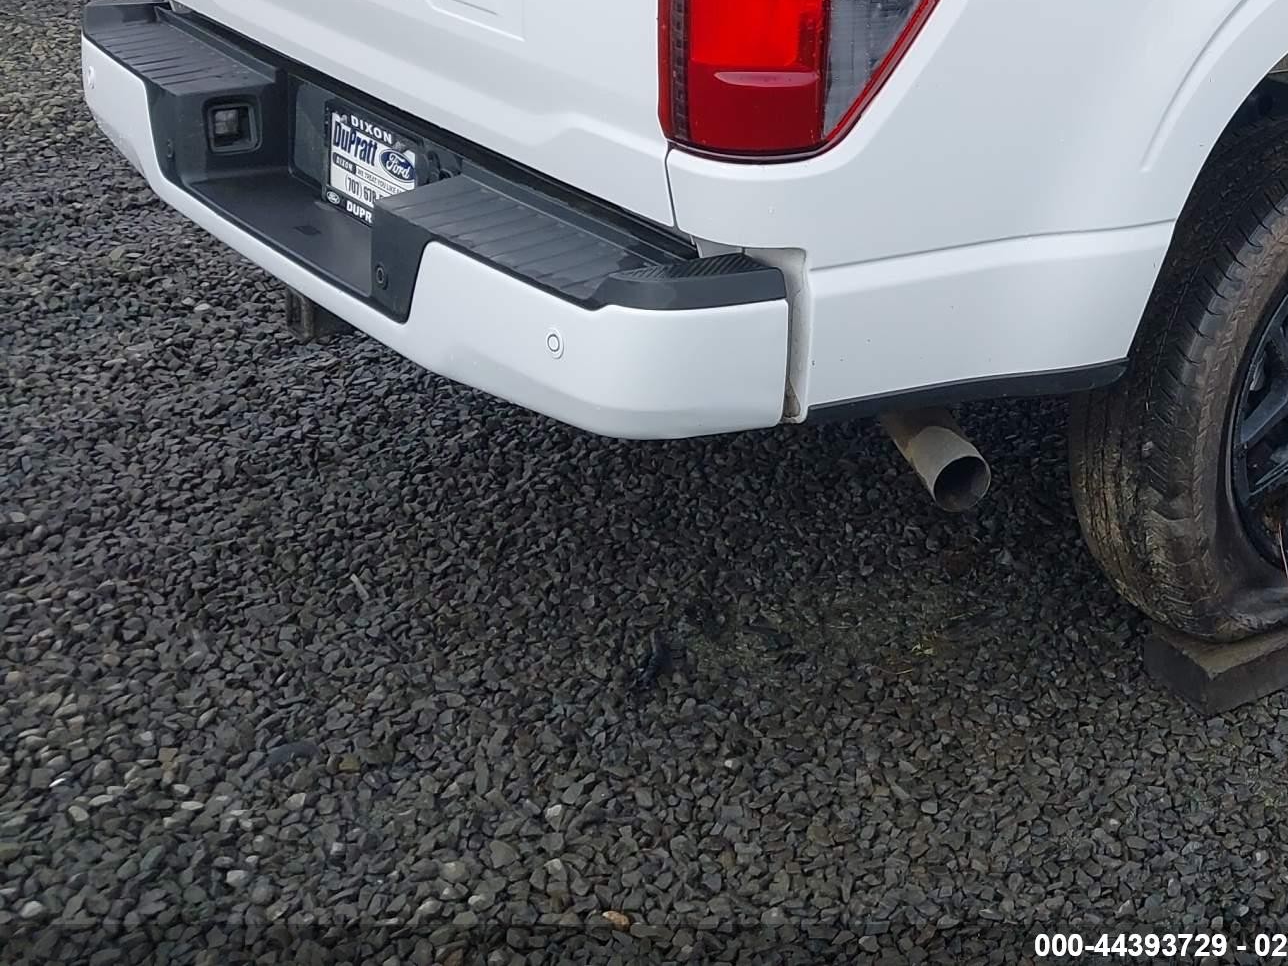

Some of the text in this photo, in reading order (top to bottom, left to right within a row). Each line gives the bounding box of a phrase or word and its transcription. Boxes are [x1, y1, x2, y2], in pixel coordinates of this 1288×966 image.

[332, 120, 378, 167] DuPratt
[350, 115, 392, 145] DIXON
[345, 173, 363, 200] (707)
